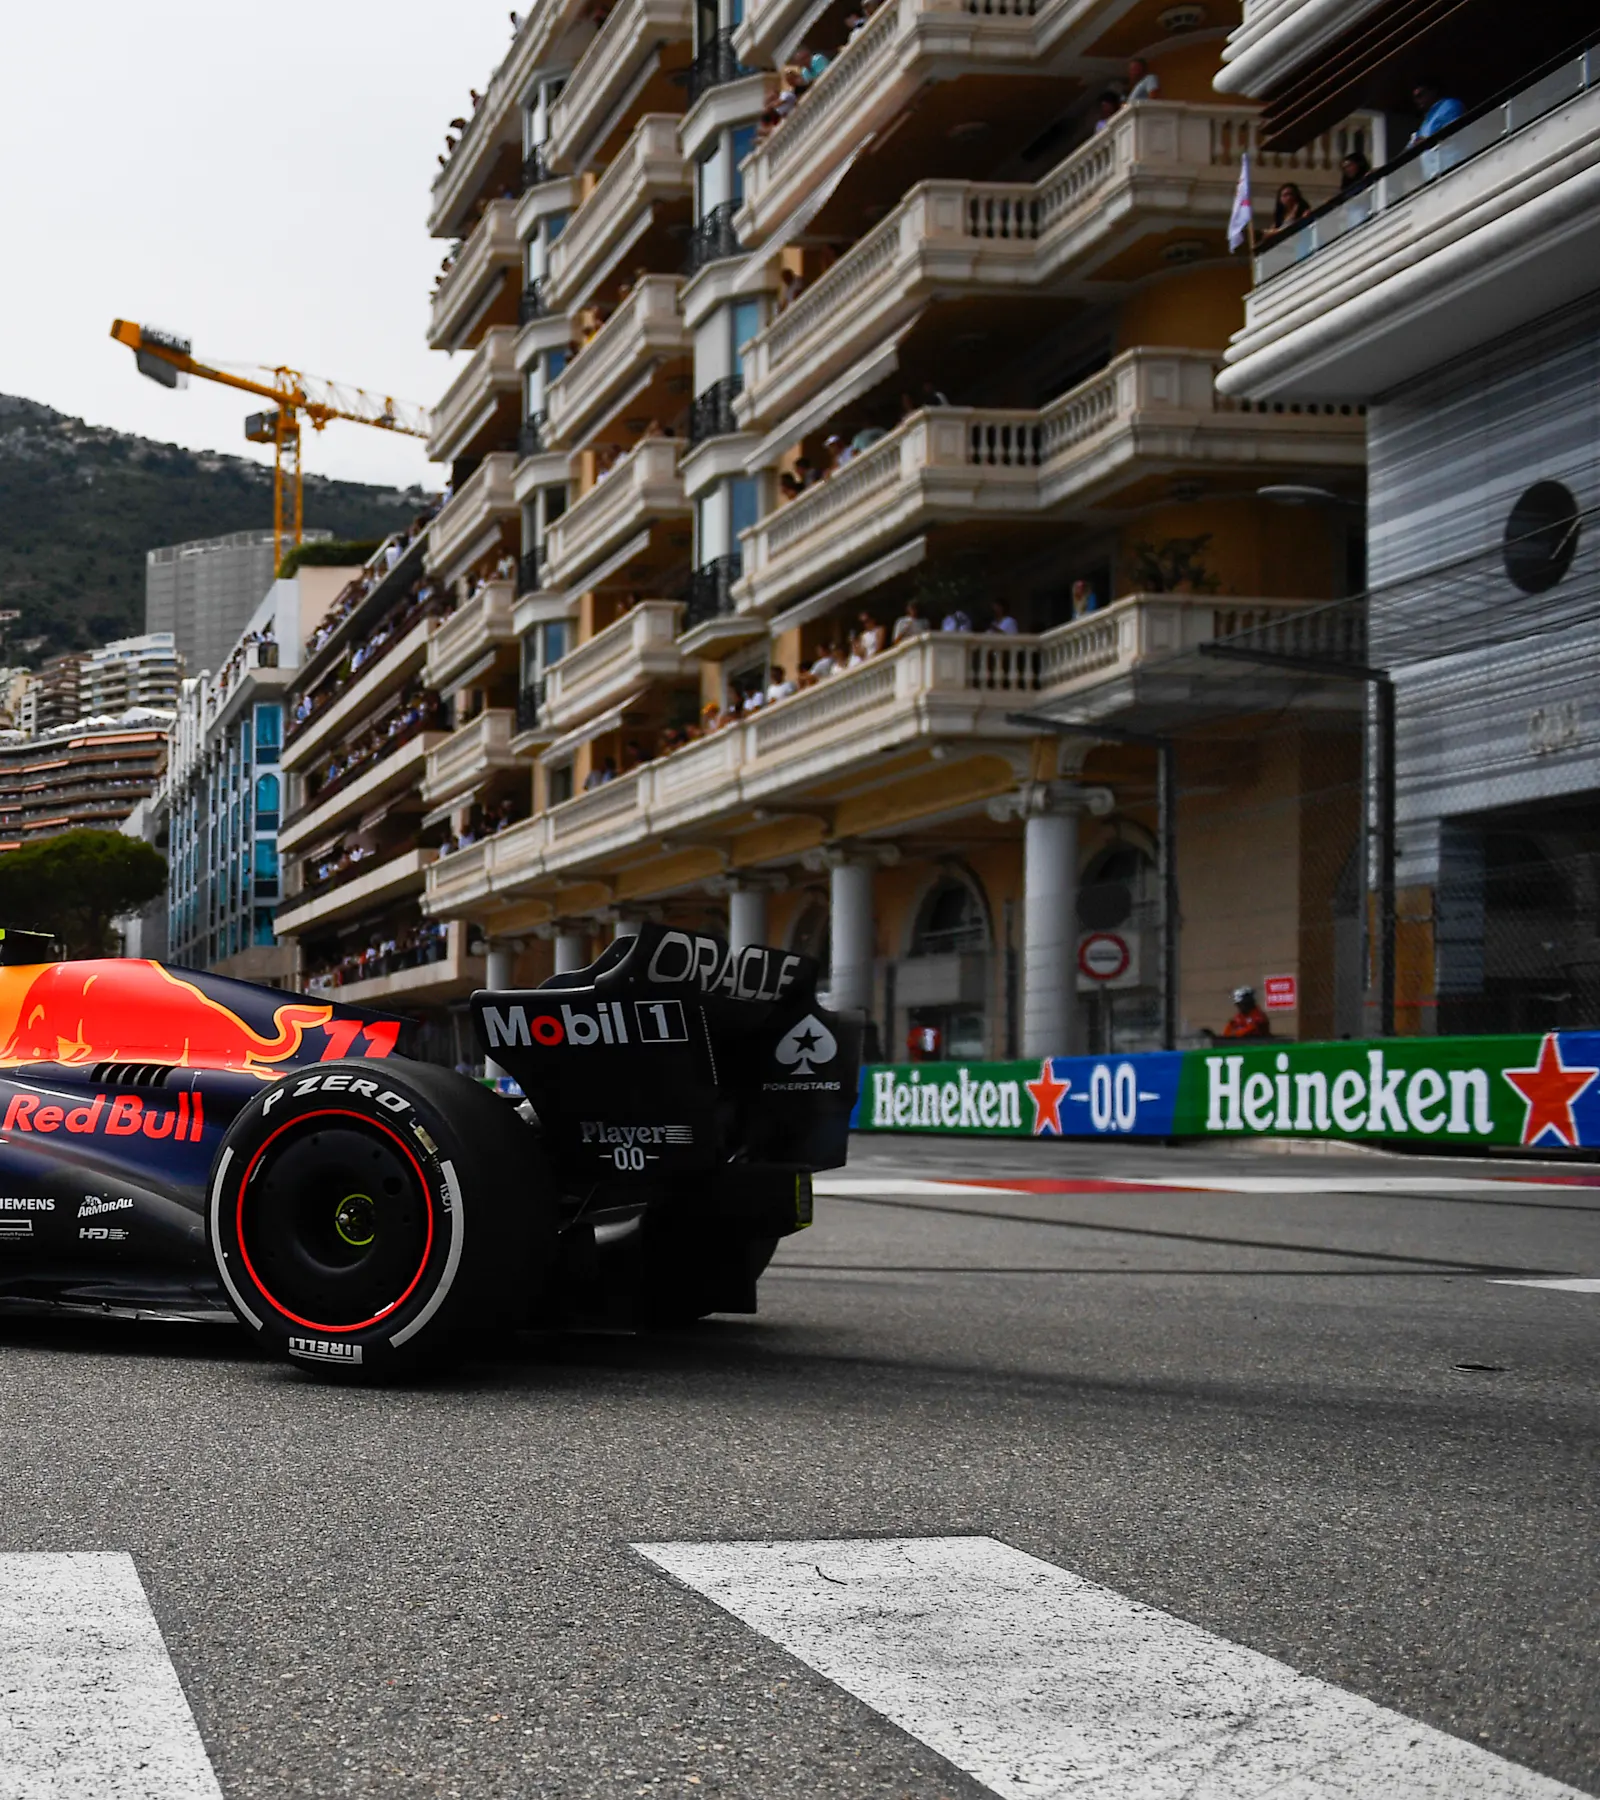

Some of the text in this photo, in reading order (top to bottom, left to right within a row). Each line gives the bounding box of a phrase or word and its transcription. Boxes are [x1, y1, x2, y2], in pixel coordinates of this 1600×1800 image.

[647, 931, 801, 1000] ORACLE
[321, 1019, 401, 1062] 11
[482, 1002, 669, 1047] Mobil 1
[262, 1075, 411, 1116] P ZERO
[763, 1081, 841, 1092] POKERSTARS
[871, 1067, 1022, 1128] Heineken
[1204, 1049, 1494, 1134] Heineken
[3, 1092, 203, 1142] Red Bull
[580, 1121, 665, 1149] Player
[289, 1337, 363, 1364] PIRELLI
